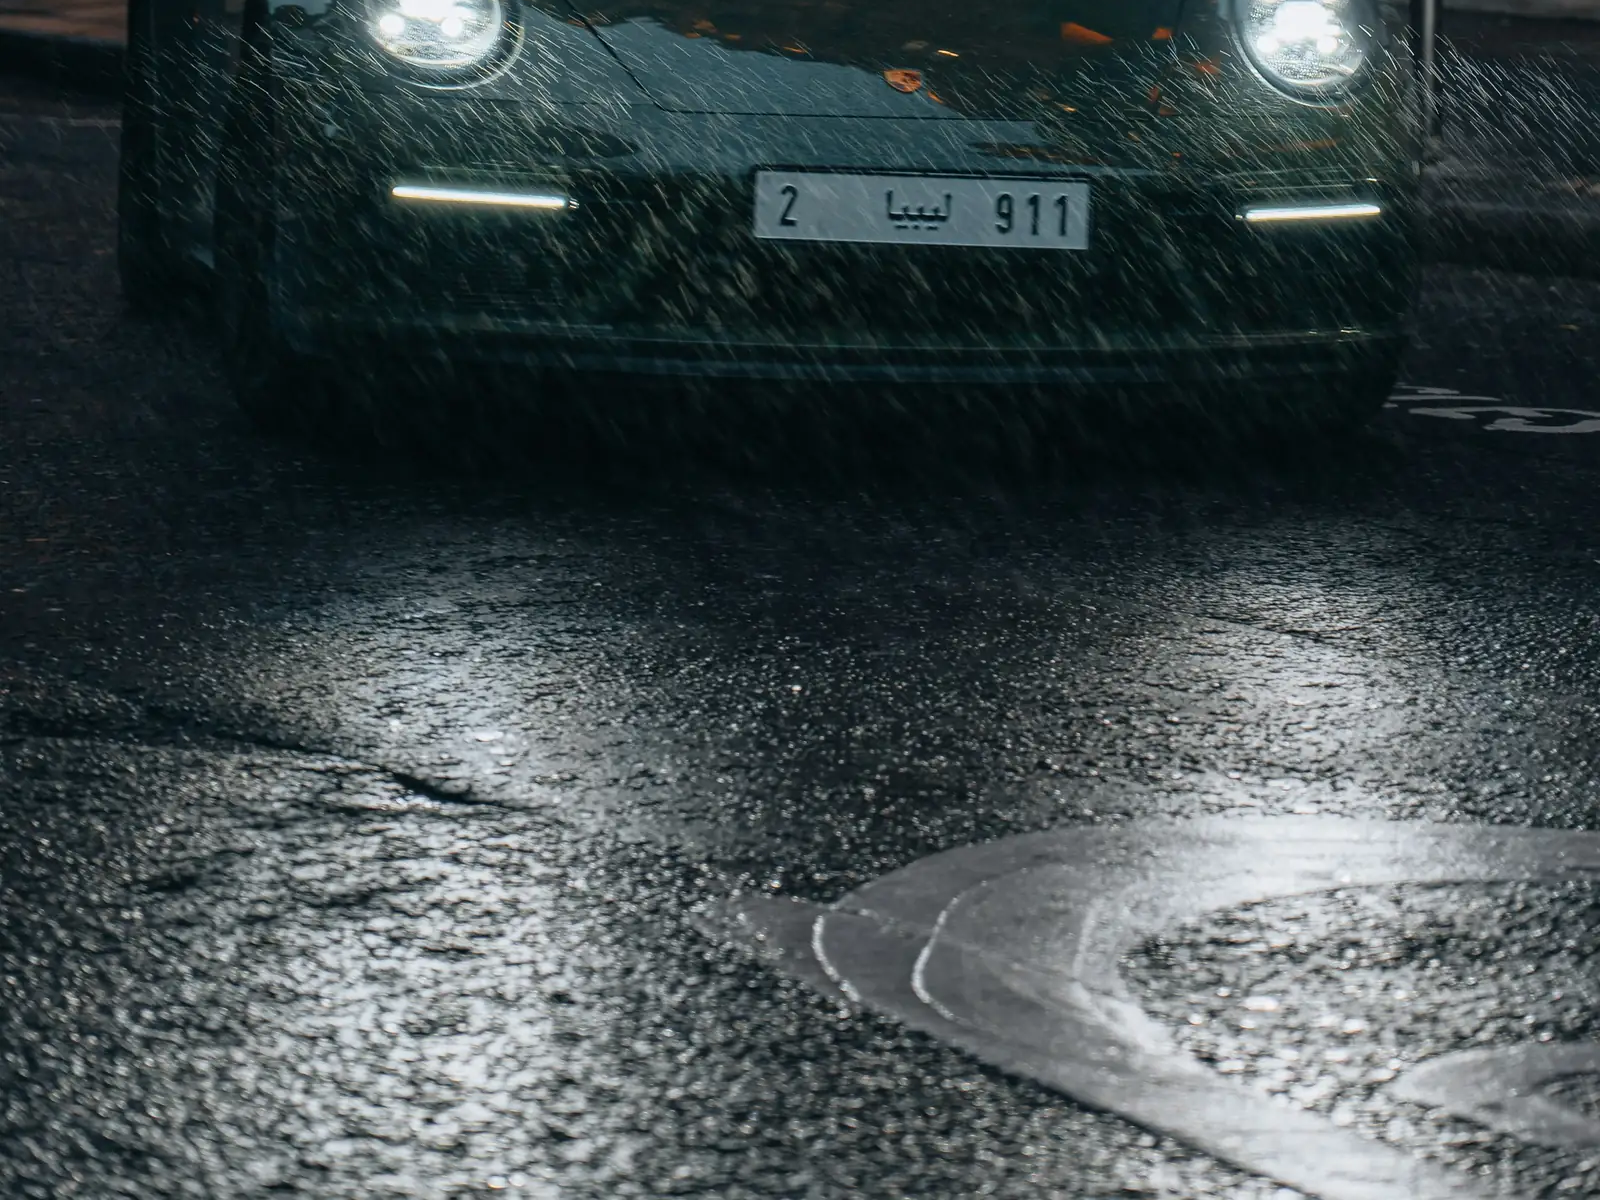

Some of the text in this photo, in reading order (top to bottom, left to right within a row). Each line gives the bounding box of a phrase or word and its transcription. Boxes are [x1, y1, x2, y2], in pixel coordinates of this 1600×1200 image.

[779, 183, 1071, 237] 2 ليبيا 911
